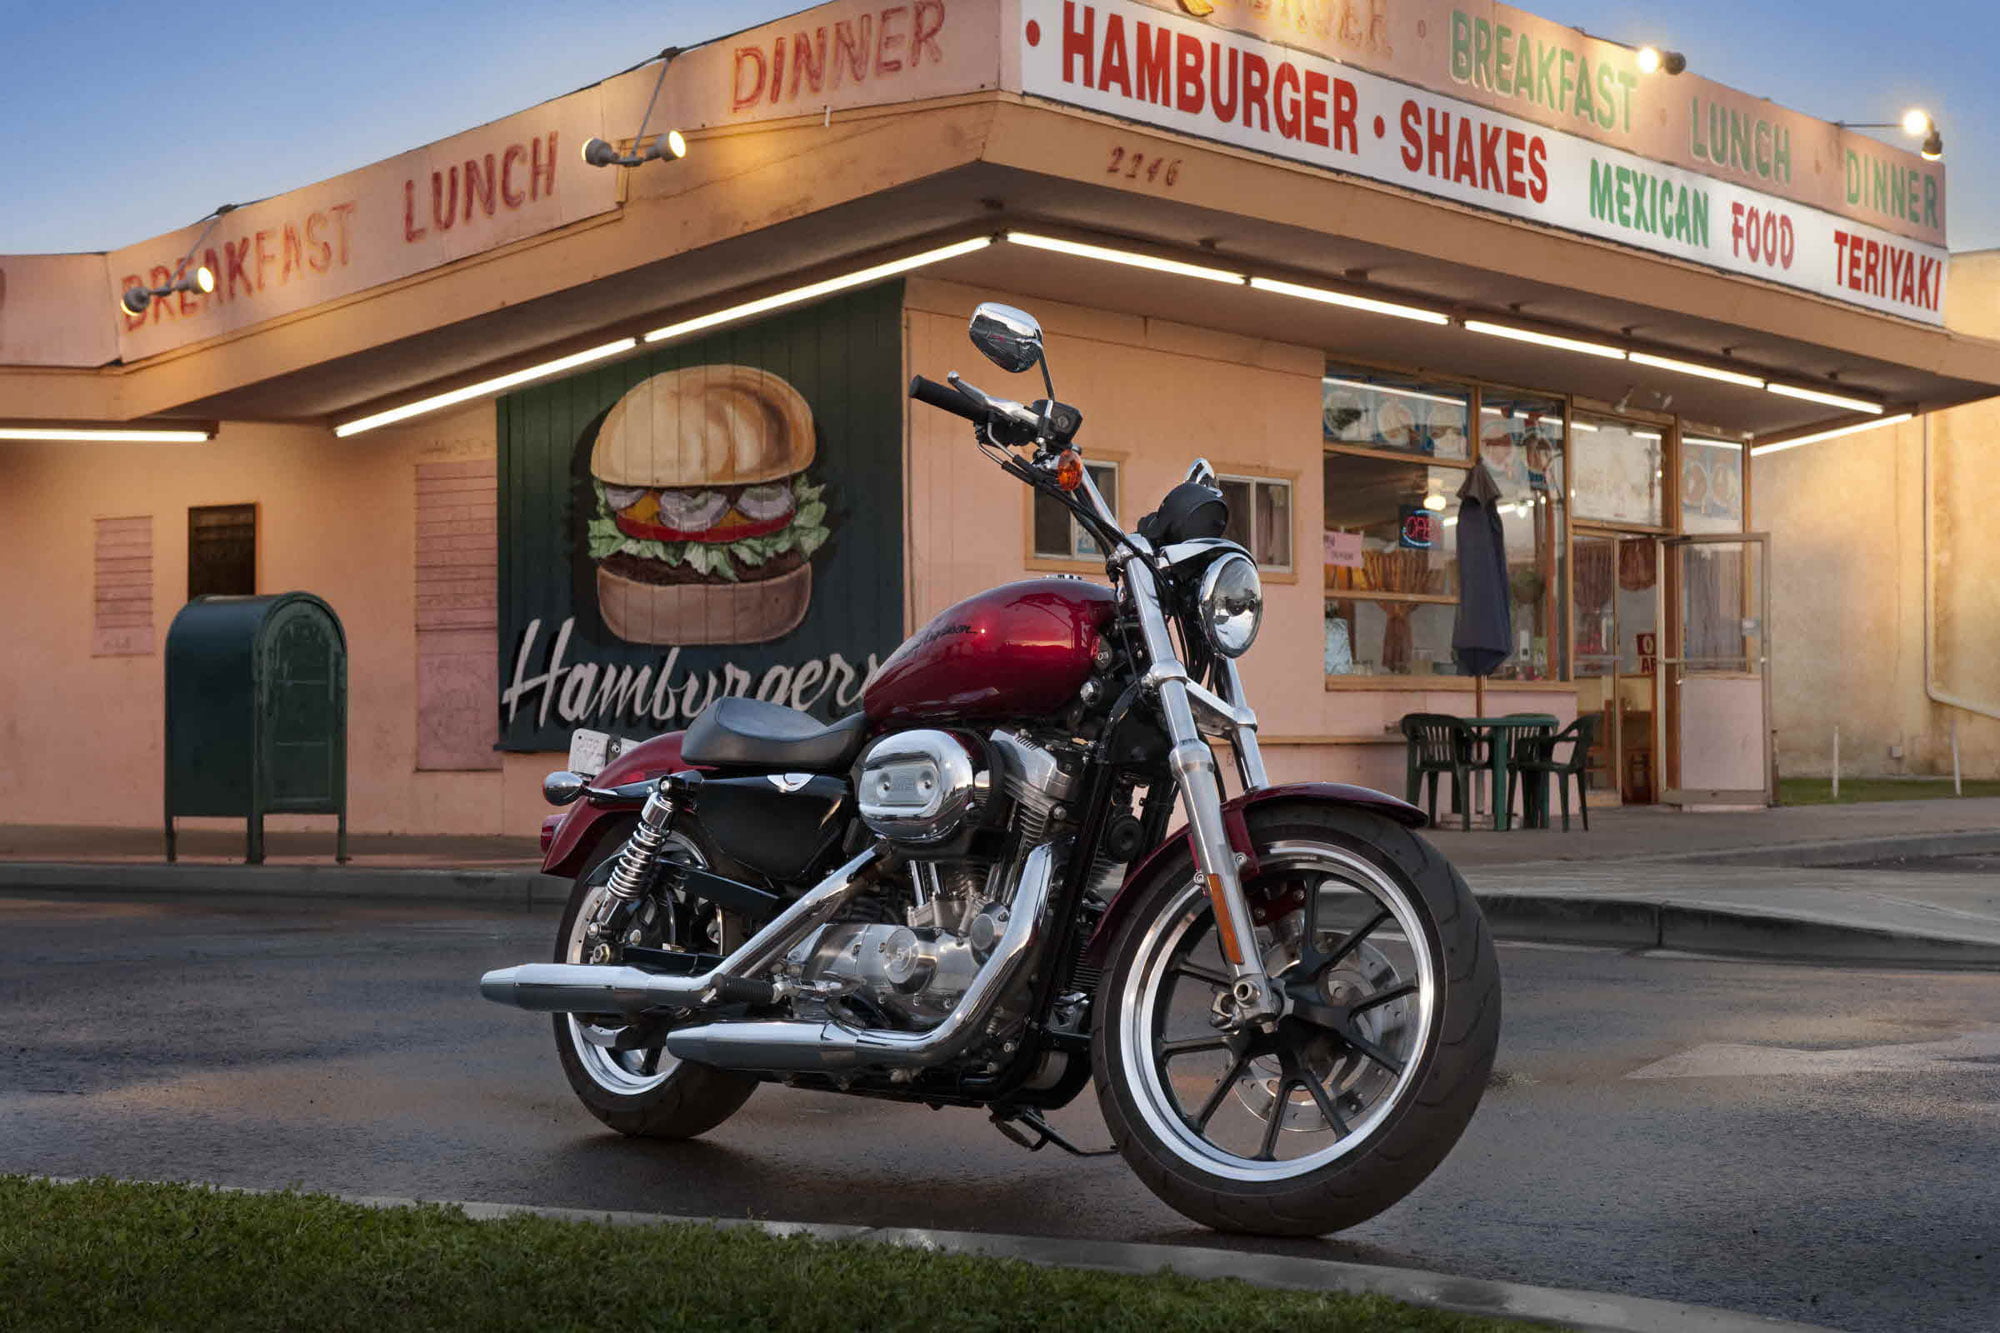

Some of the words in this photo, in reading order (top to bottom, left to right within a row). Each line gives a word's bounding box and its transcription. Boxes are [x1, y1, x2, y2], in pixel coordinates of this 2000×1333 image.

[122, 200, 356, 332] BREAKFAST
[404, 130, 558, 243] LUNCH
[731, 0, 945, 114] DINNER
[1062, 0, 1358, 156] HAMBURGER
[1400, 99, 1548, 204] SHAKES
[1589, 157, 1709, 249] MEXICAN
[1731, 201, 1794, 270] FOOD
[1834, 229, 1941, 312] TERIYAKI
[1448, 8, 1637, 134] BREAKFAST
[1689, 95, 1791, 186] LUNCH
[1845, 147, 1939, 230] DINNER
